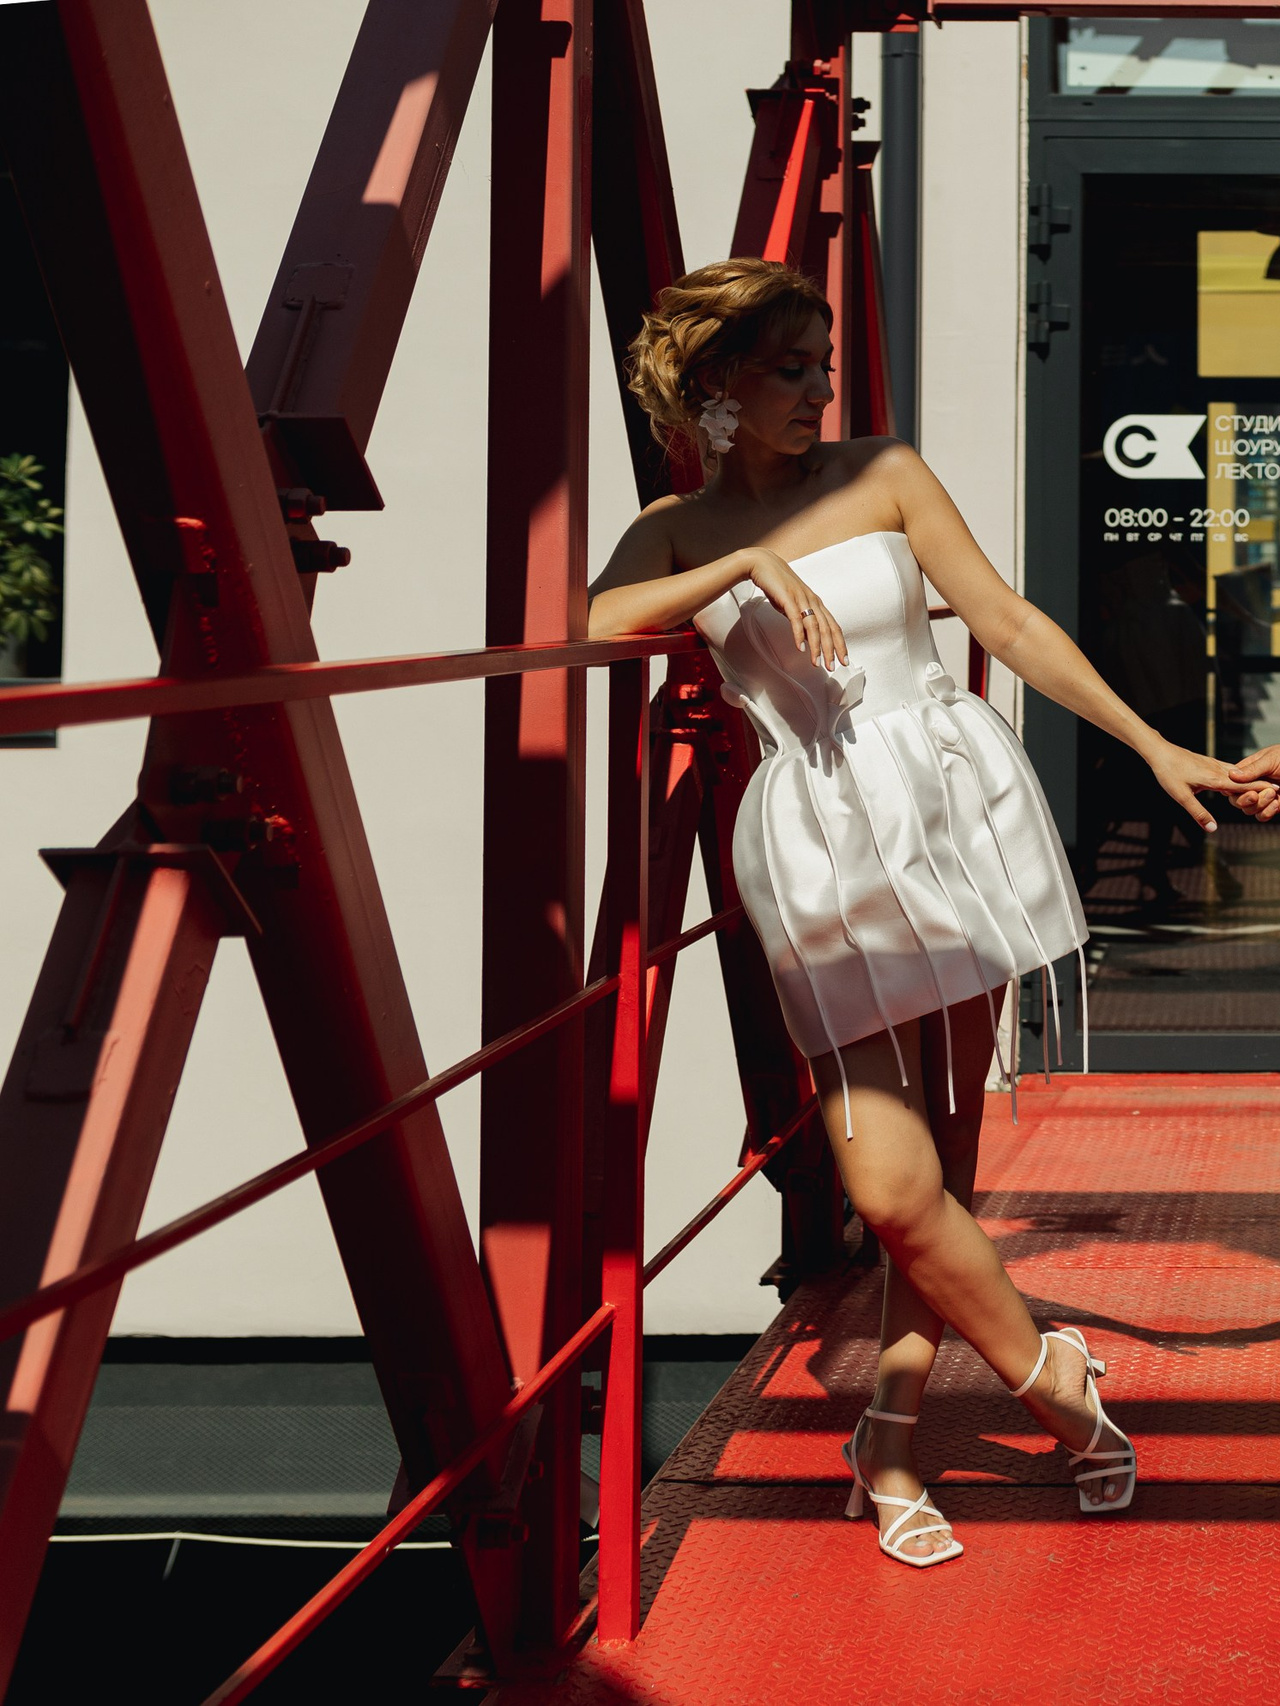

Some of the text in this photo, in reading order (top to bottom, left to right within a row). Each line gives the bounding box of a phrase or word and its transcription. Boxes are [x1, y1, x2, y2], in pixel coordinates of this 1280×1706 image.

[1104, 508, 1168, 528] 08:00
[1189, 508, 1250, 528] 22:00
[1103, 532, 1249, 542] ПН ВТ СР ЧТ ПТ СБ ВС
